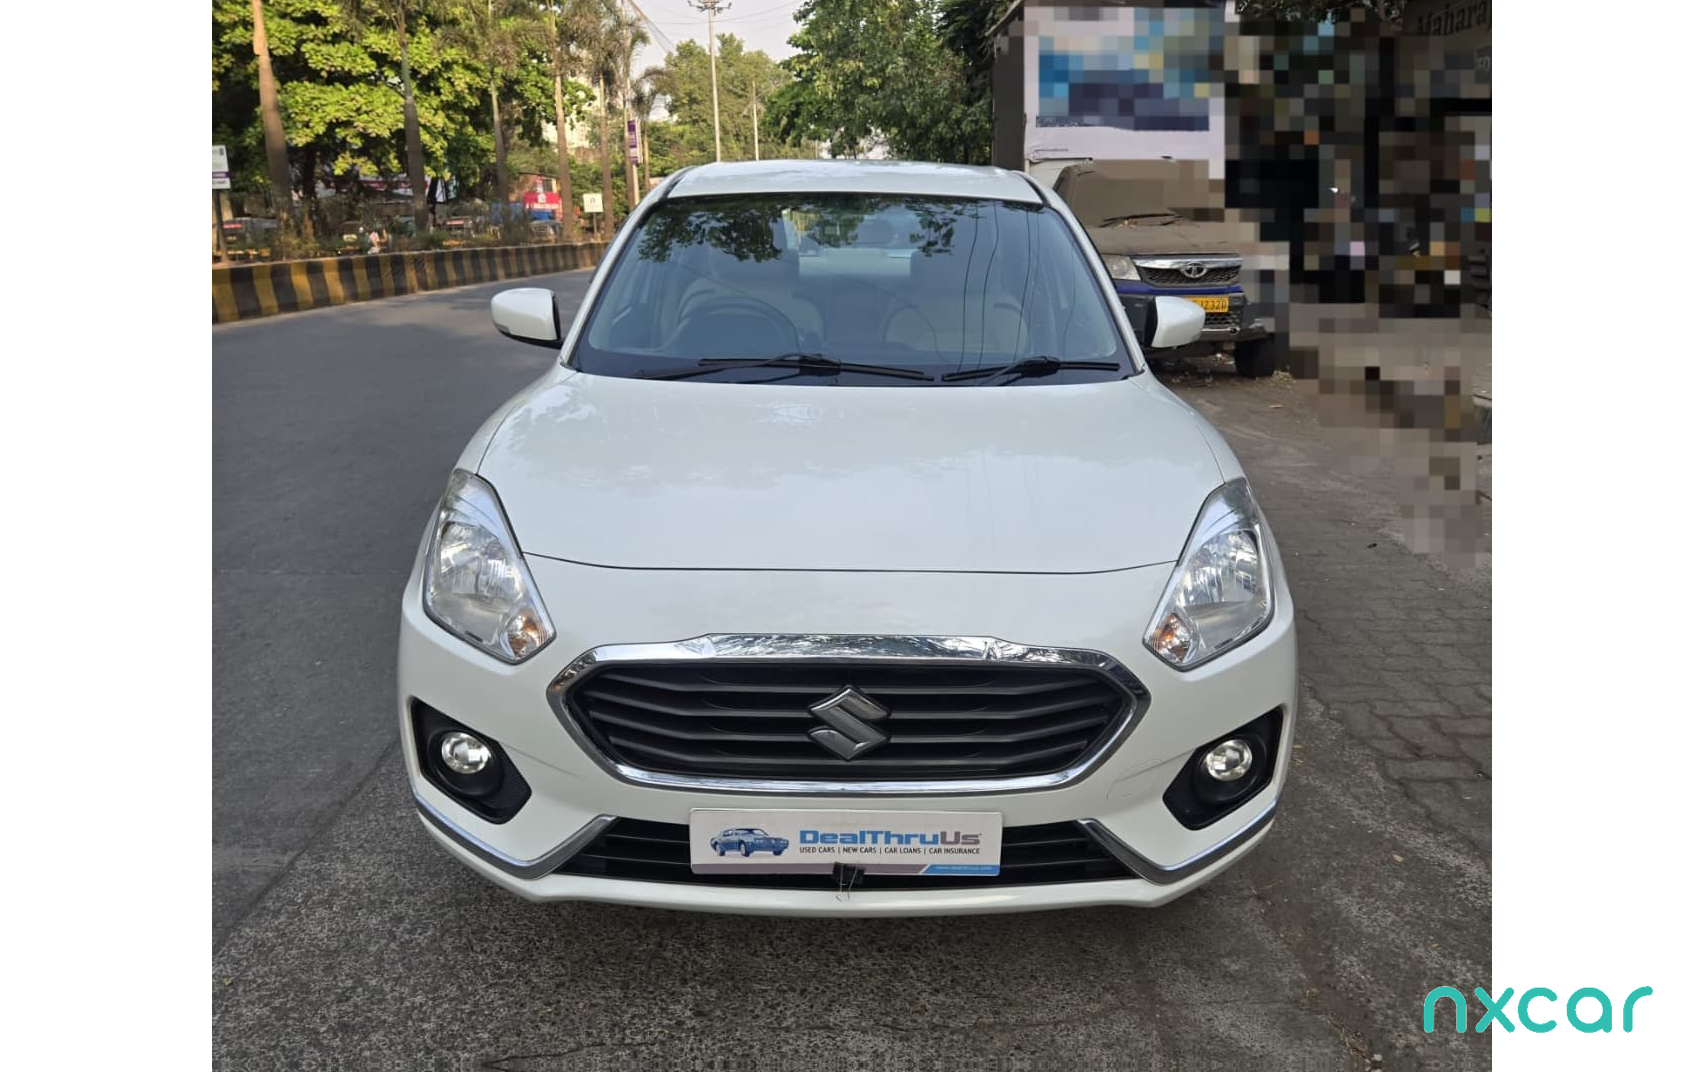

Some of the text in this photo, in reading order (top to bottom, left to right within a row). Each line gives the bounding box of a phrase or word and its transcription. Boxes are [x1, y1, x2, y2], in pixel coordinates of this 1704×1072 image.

[800, 830, 980, 845] DealThruUs
[800, 846, 817, 854] USED
[818, 846, 836, 854] CARS
[900, 847, 921, 855] LOANS
[929, 847, 942, 855] CAR
[944, 847, 980, 855] INSURANCE
